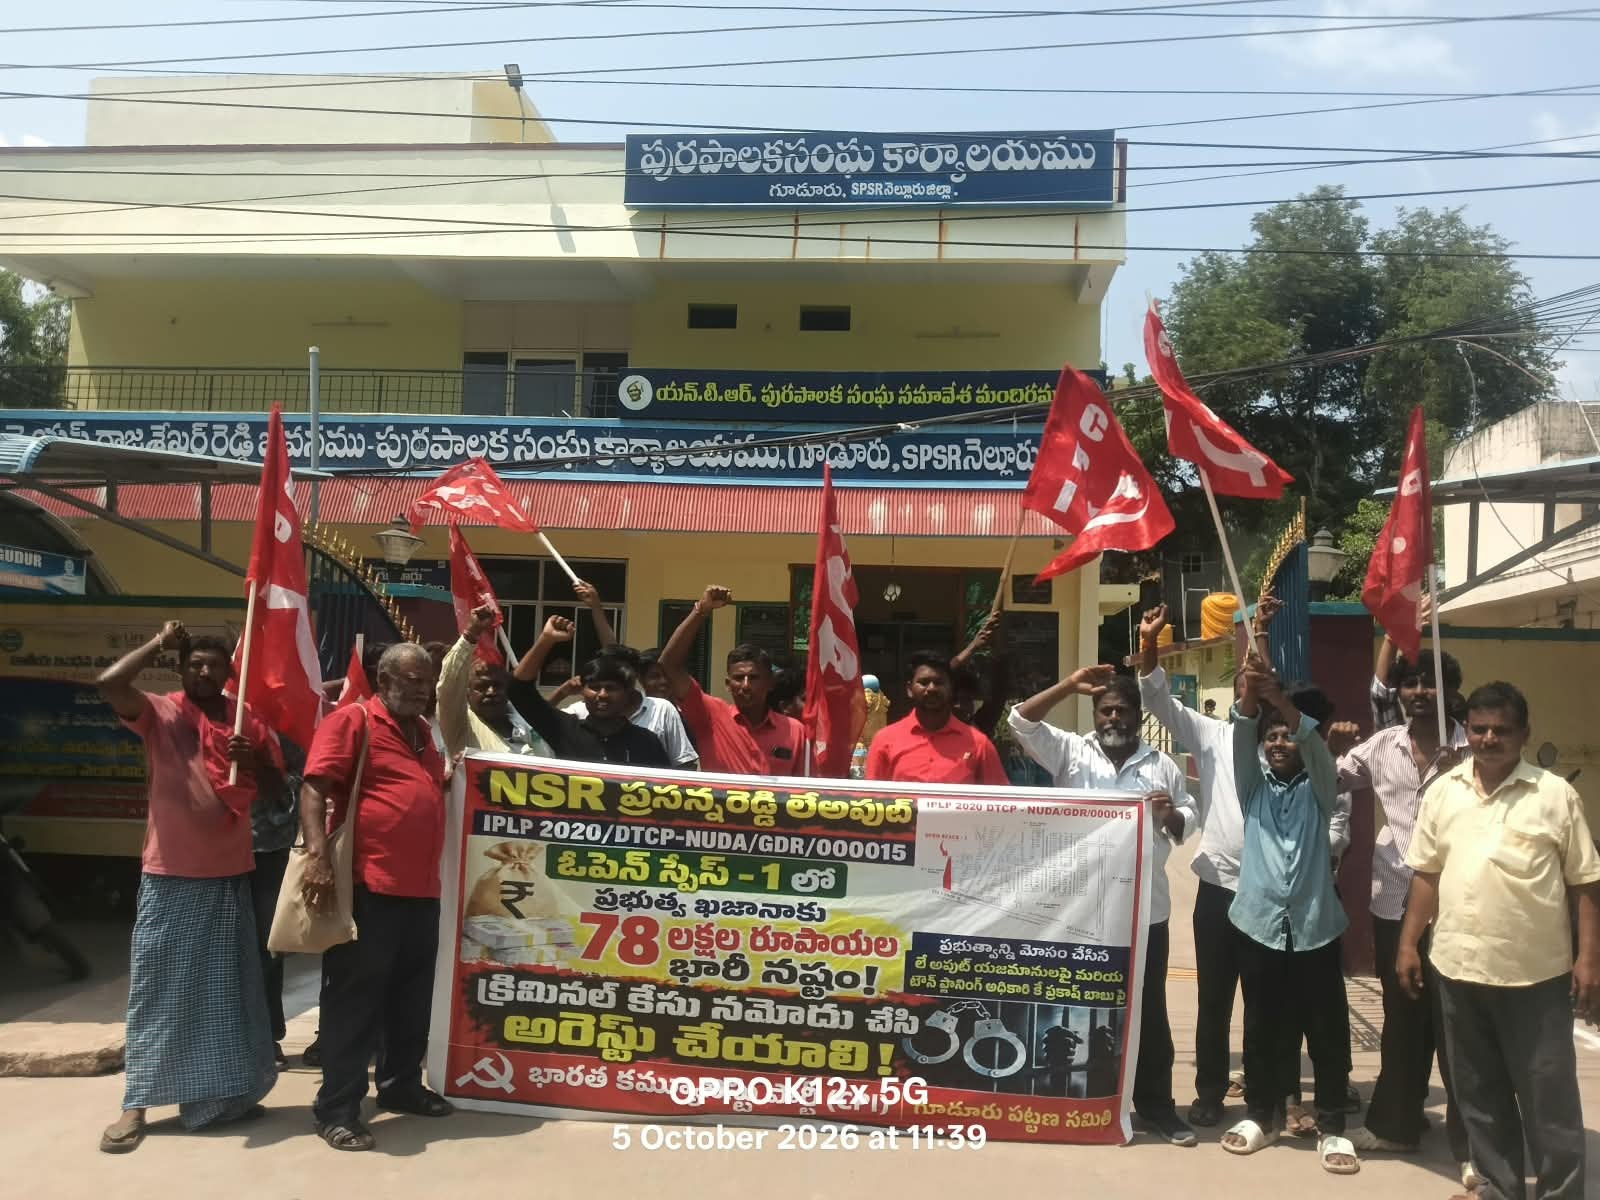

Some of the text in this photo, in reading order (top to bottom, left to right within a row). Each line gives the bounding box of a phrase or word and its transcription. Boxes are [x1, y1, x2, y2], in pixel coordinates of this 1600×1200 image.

[882, 134, 1097, 184] కార్యాలయము
[761, 382, 844, 408] పురపాలక
[897, 382, 973, 404] సమావేశ
[488, 769, 607, 812] NSR
[955, 802, 983, 812] 2020
[483, 813, 536, 834] IPLP
[557, 849, 652, 882] ఓపెన్
[658, 852, 731, 894] స్పేస్
[791, 866, 837, 892] లో
[593, 886, 828, 924] ప్రభుత్వ ఖజానాకు
[579, 911, 899, 967] 78 లక్షల రూపాయల
[1018, 943, 1068, 960] మోసం
[1071, 946, 1110, 963] చేసిన
[668, 952, 752, 985] భారీ
[477, 973, 920, 1036] క్రిమినల్ కేసు నమోదు చేసి
[503, 1009, 657, 1064] అరెస్టు
[527, 1064, 609, 1090] భారత
[911, 1098, 1003, 1123] గూడూరు
[1007, 1105, 1061, 1135] పట్టణ
[1064, 1108, 1113, 1130] సమితి
